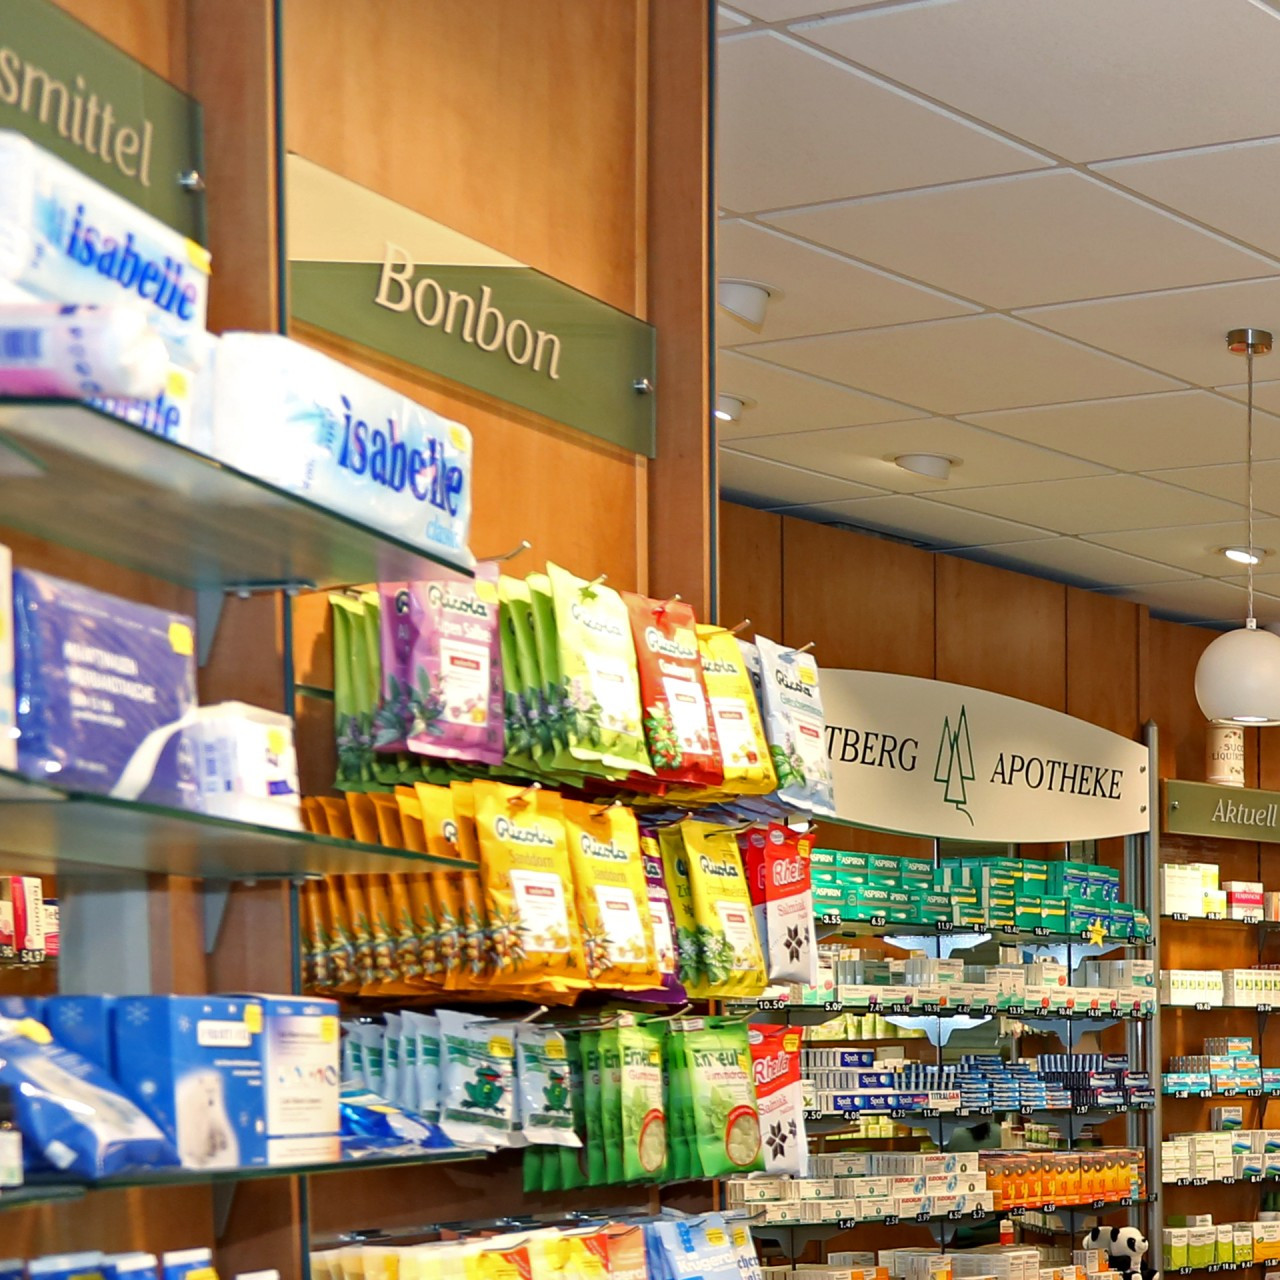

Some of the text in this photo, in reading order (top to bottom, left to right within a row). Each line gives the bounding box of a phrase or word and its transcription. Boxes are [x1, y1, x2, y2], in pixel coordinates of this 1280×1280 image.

[66, 206, 199, 320] isabelle
[374, 242, 562, 380] Bonbon
[338, 394, 464, 518] isabelle
[428, 581, 489, 617] Ricola
[647, 627, 696, 657] Ricola
[775, 668, 813, 698] Ricola
[824, 724, 1124, 801] TBERG APOTHEKE
[1212, 798, 1278, 828] Aktuell
[496, 818, 554, 846] Ricola
[581, 834, 628, 860] Ricola
[700, 855, 739, 878] Ricola
[841, 856, 866, 866] ASPIRIN
[874, 859, 898, 869] ASPIRIN
[907, 861, 931, 872] ASPIRIN
[815, 887, 841, 897] ASPIRIN
[863, 888, 888, 899] ASPIRIN
[926, 894, 950, 905] ASPIRIN
[823, 916, 842, 925] 3.55
[872, 917, 886, 926] 6.59
[758, 1000, 785, 1010] 10.50
[825, 1003, 842, 1011] 5.09
[844, 1053, 859, 1064] Spalt
[753, 1052, 790, 1085] Rheila
[862, 1074, 877, 1085] Spalt
[836, 1096, 852, 1107] Spalt
[869, 1095, 886, 1106] Spalt
[930, 1092, 961, 1101] TITRALGAN
[837, 1219, 855, 1228] 1.49
